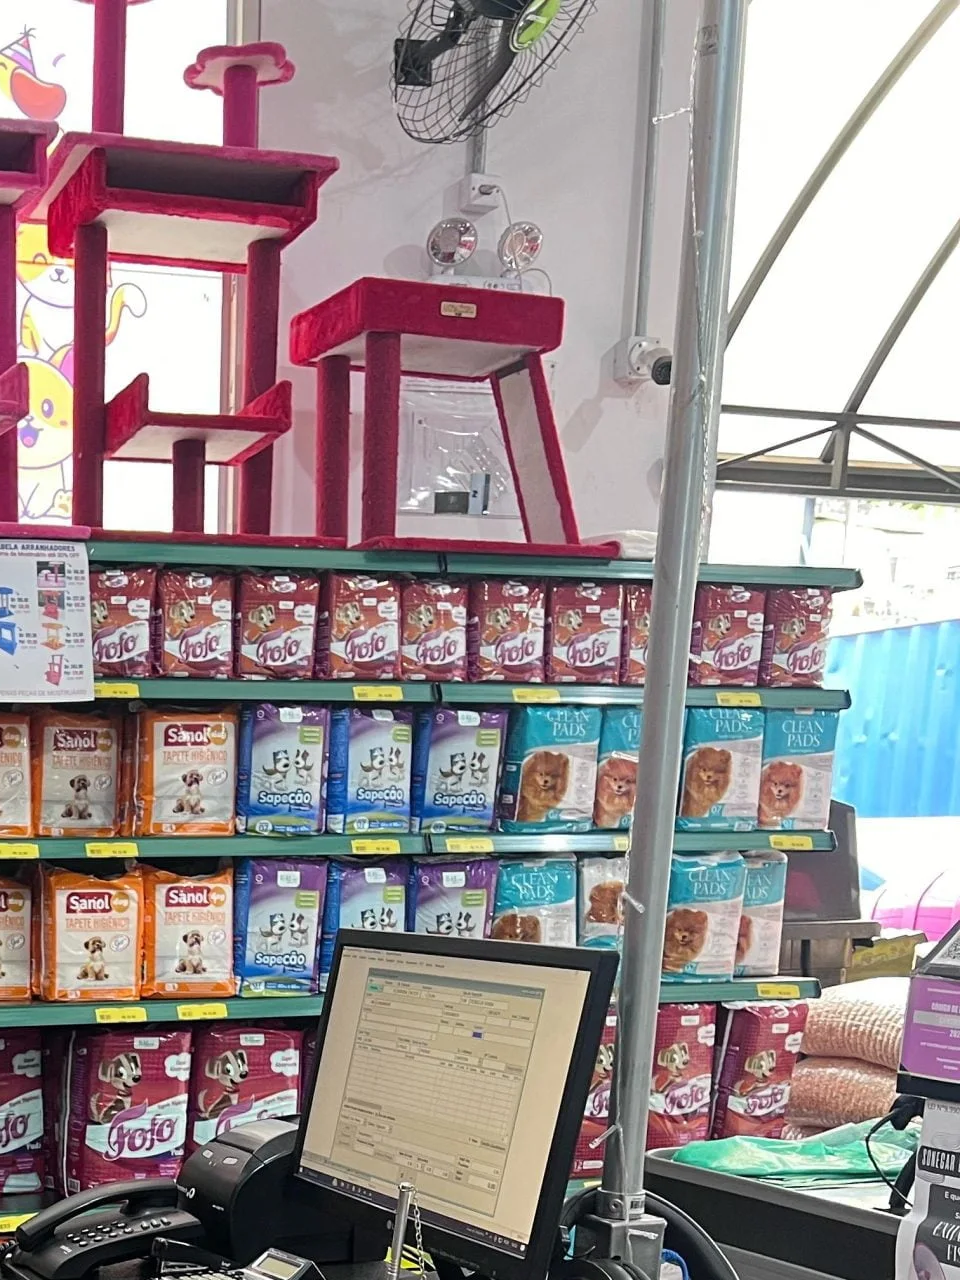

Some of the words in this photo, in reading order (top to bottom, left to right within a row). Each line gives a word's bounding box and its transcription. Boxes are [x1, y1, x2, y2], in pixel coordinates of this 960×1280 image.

[552, 723, 586, 737] PADS
[715, 720, 749, 733] PADS
[782, 720, 824, 734] CLEAN
[56, 731, 95, 748] Sanol
[167, 728, 209, 743] Sanol
[787, 734, 821, 748] PADS
[258, 788, 311, 806] Sapecão
[357, 785, 404, 802] Sapecão
[434, 791, 486, 807] Sapecão
[688, 869, 731, 882] CLEAN
[693, 881, 728, 896] PADS
[69, 895, 111, 911] Sanol
[169, 889, 209, 905] Sanol
[255, 951, 307, 968] Sapecão
[922, 1149, 955, 1173] SONEGAR
[944, 1190, 950, 1199] E
